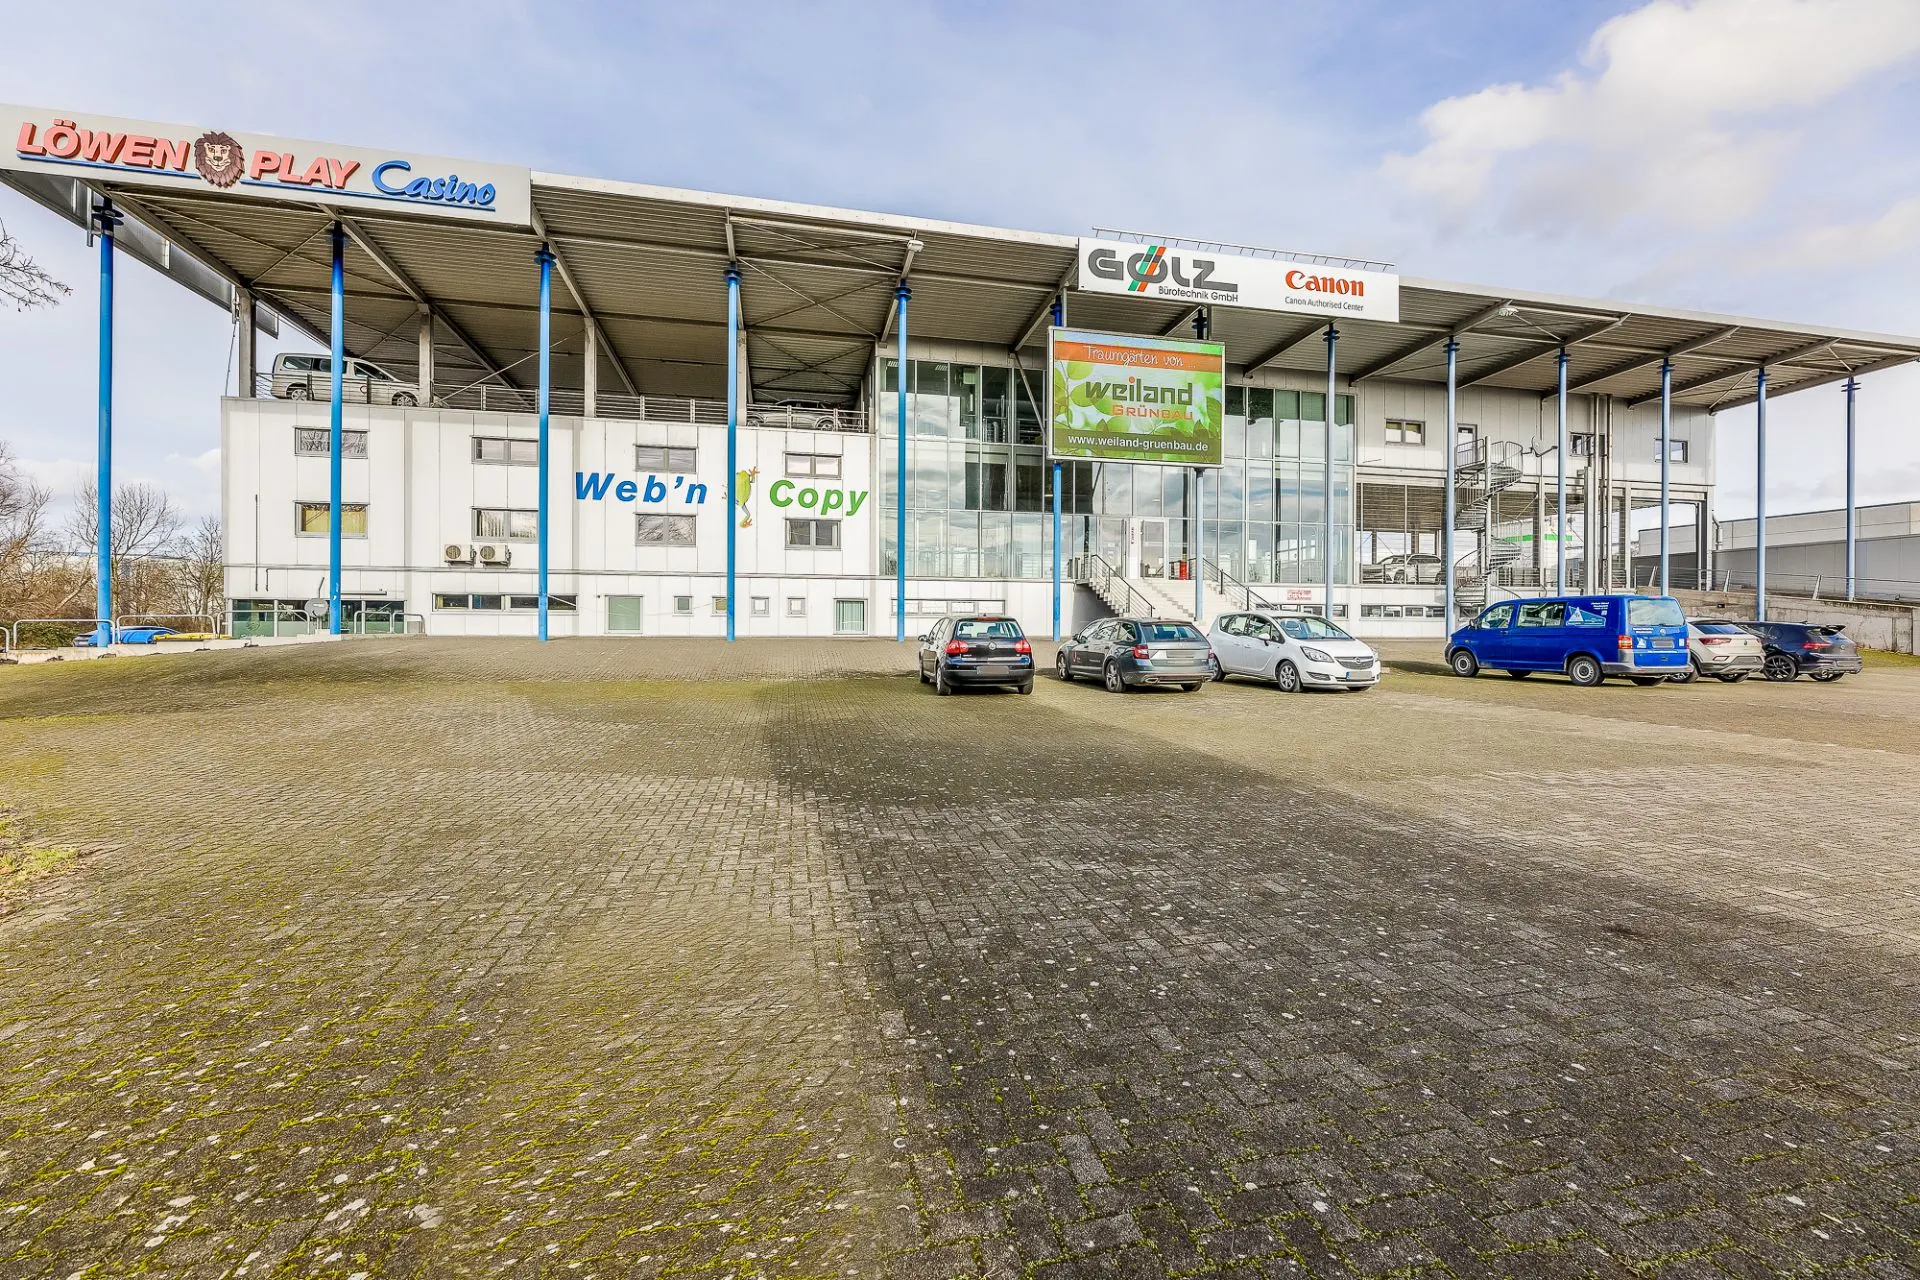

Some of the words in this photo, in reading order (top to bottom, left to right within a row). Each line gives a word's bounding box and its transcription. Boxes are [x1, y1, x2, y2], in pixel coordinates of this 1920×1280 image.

[16, 118, 190, 171] LÖWEN
[250, 150, 360, 190] PLAY
[371, 160, 497, 207] Casino
[1158, 285, 1209, 300] Bürotechnik
[1211, 293, 1239, 302] GmbH
[1285, 270, 1364, 297] Canon
[1285, 296, 1307, 305] Canon
[1307, 298, 1342, 309] Authorised
[1343, 302, 1364, 311] Center
[1082, 345, 1159, 367] Traumgärten
[1163, 355, 1184, 367] von
[1085, 376, 1193, 406] weiland
[1068, 435, 1209, 452] www.weiland-gruenbau.de
[769, 479, 869, 517] Copy
